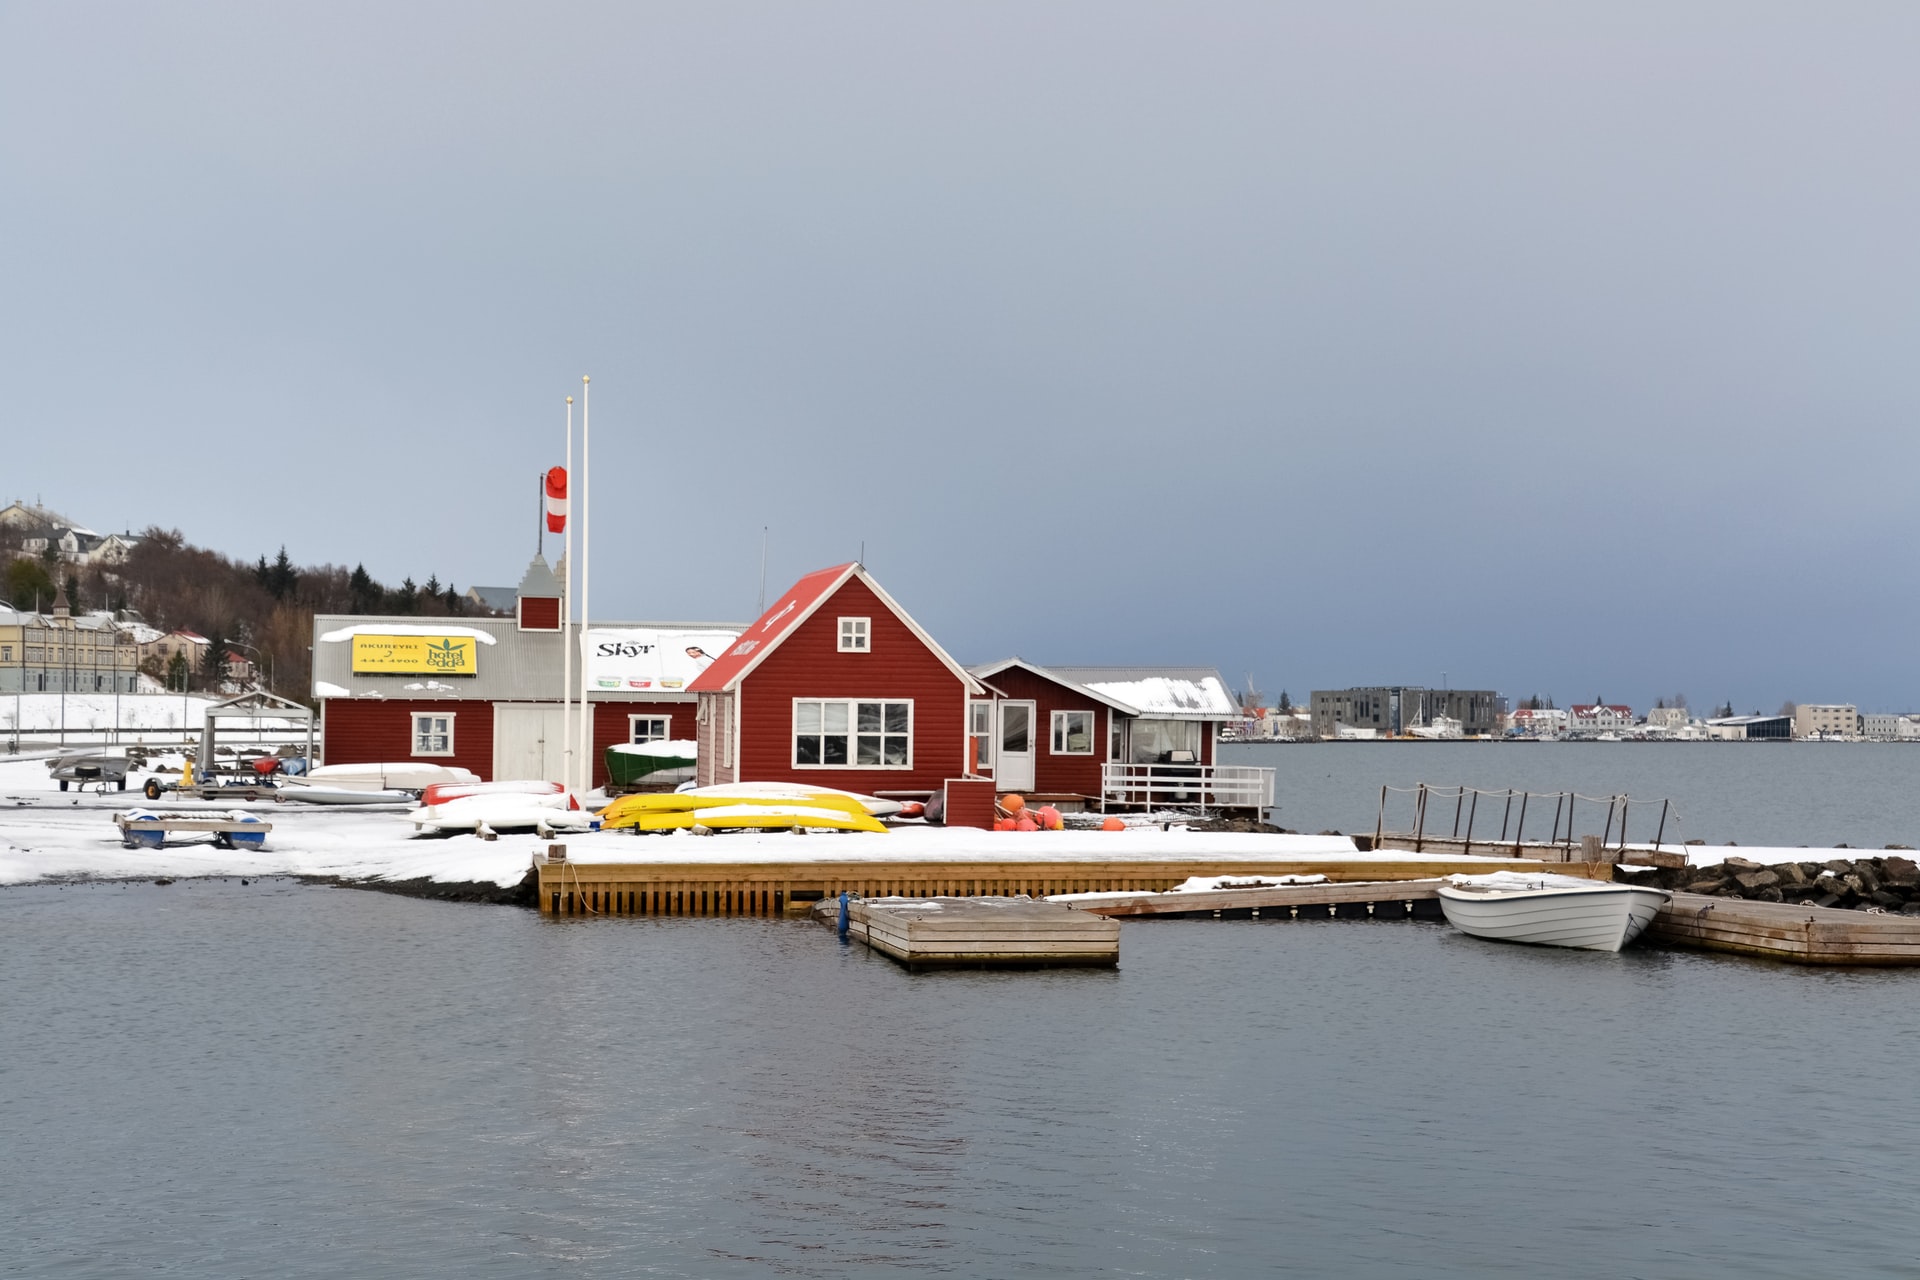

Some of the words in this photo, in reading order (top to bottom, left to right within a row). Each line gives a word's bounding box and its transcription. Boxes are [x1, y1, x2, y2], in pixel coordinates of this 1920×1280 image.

[429, 649, 463, 660] hotel
[596, 642, 655, 658] Skyr
[426, 658, 465, 667] edda
